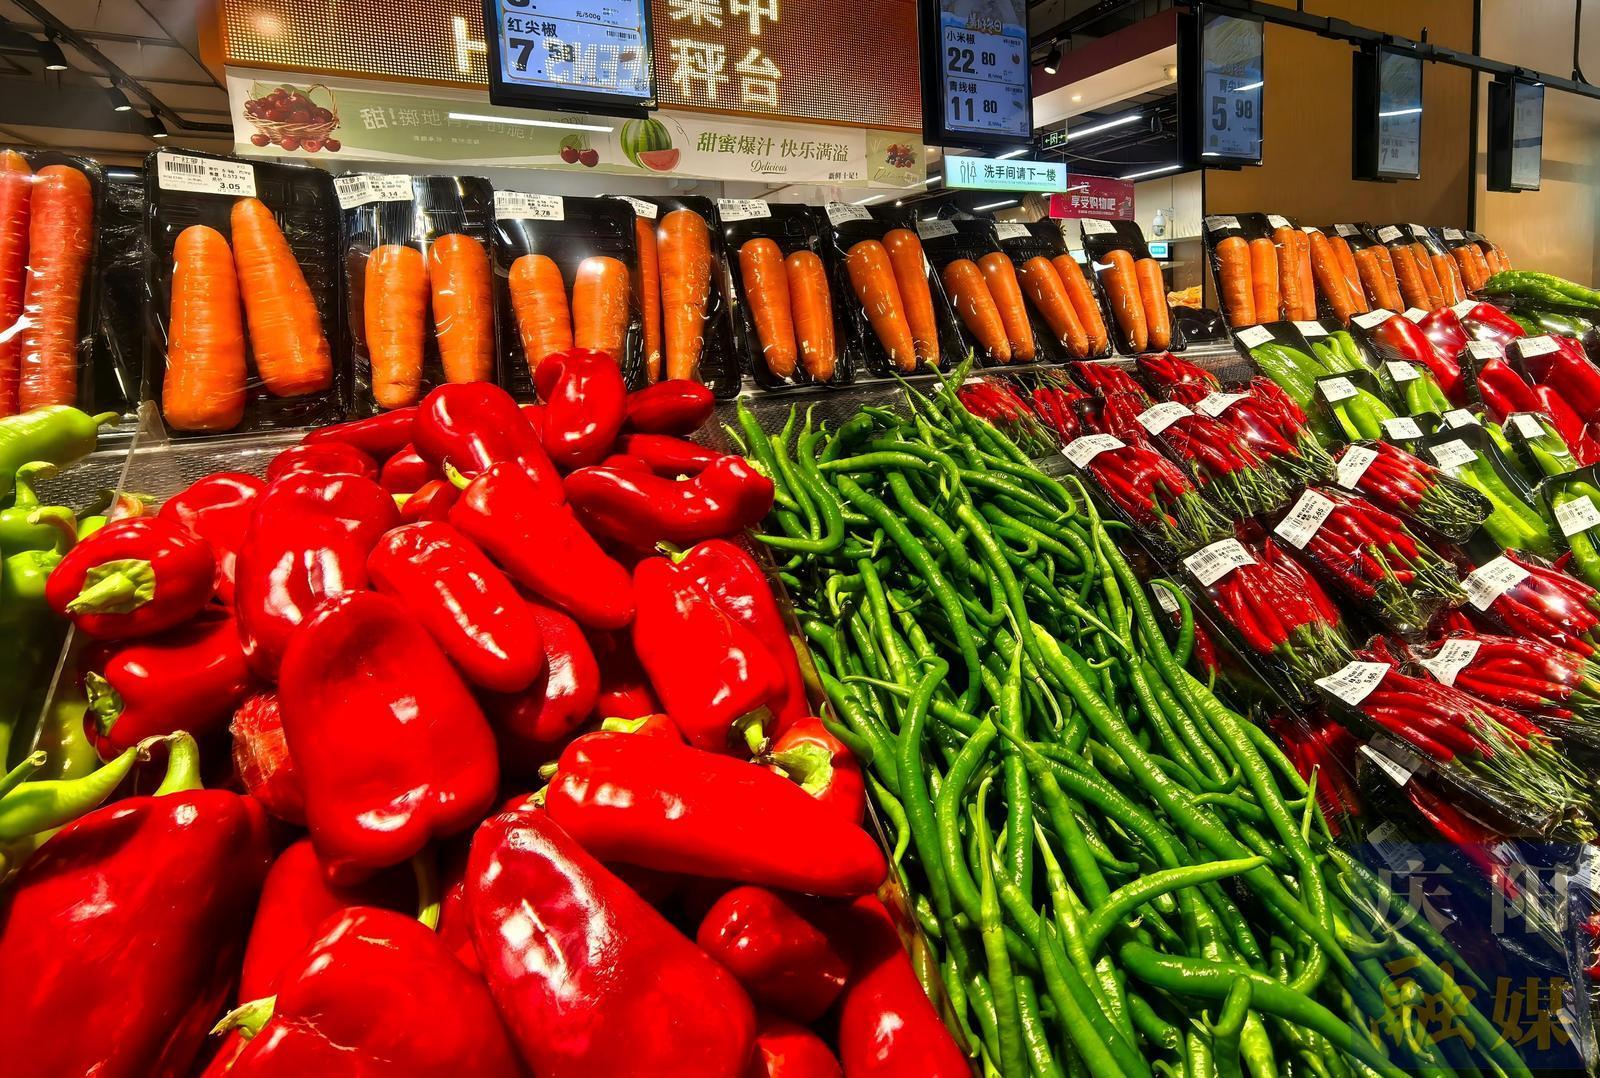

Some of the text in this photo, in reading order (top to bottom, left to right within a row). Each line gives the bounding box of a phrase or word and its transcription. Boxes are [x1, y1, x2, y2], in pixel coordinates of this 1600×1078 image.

[508, 17, 558, 38] 红尖椒
[947, 31, 976, 45] 小米椒
[669, 38, 782, 107] 秤台
[949, 81, 977, 94] 青线椒
[697, 132, 848, 162] 甜蜜爆汁 快乐满溢
[750, 160, 787, 174] Delicious
[984, 164, 1057, 182] 洗手间请下一楼
[220, 182, 240, 190] 3.05
[1071, 195, 1116, 211] 享受购物吧
[1311, 507, 1324, 521] 5.65
